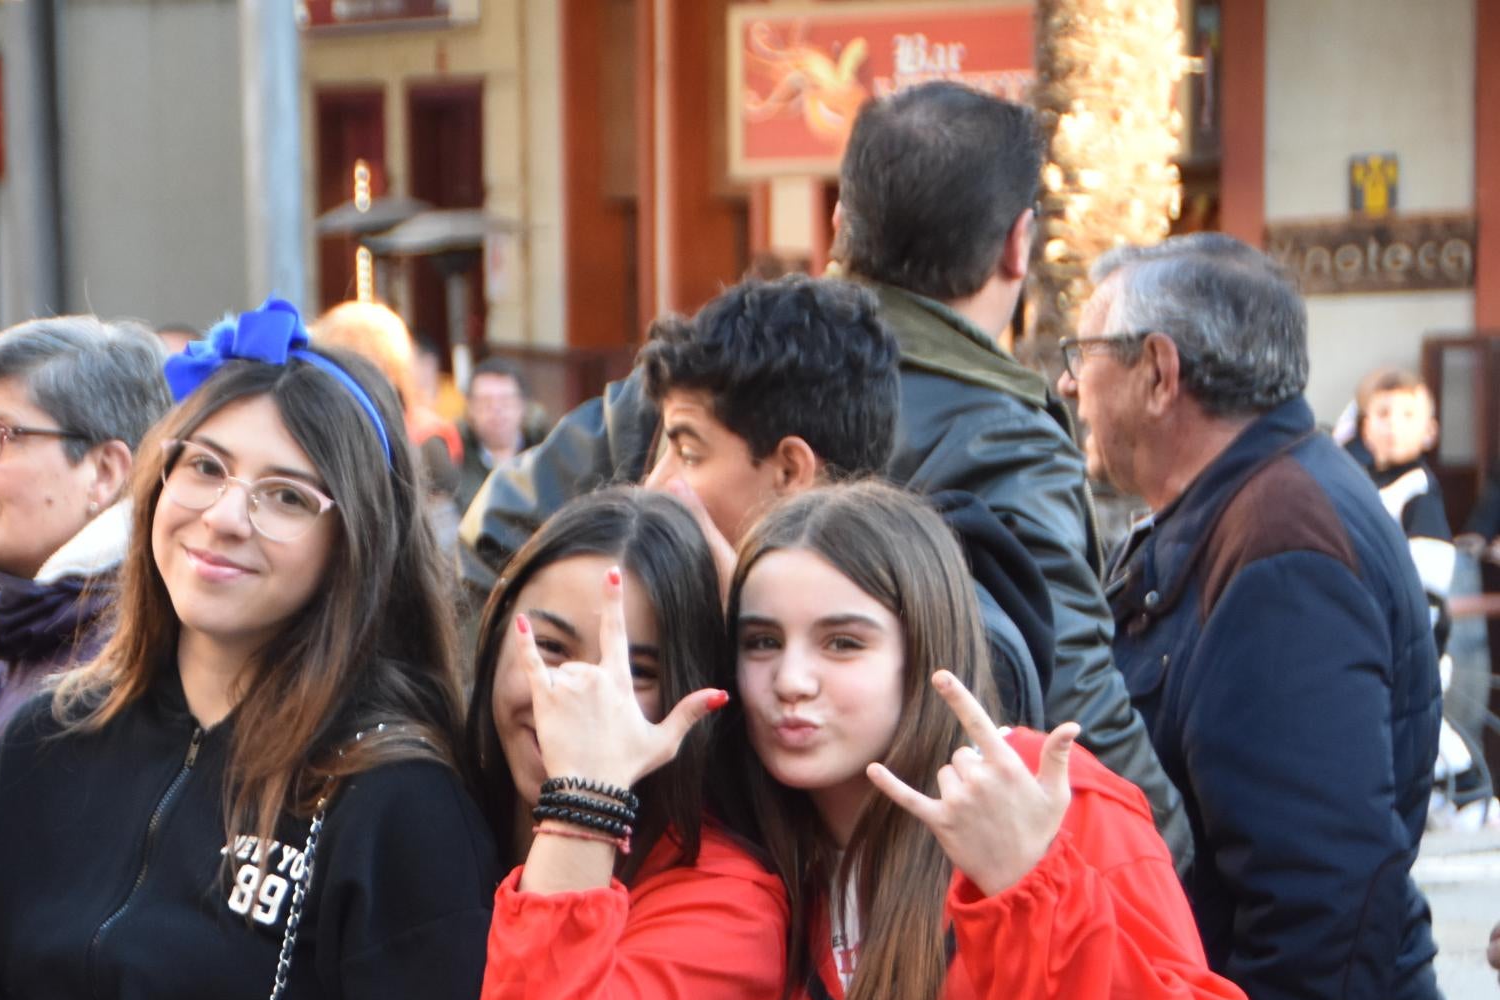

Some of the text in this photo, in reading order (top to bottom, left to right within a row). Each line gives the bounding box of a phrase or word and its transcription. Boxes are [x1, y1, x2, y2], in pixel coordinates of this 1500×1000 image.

[893, 33, 967, 73] Bar
[277, 845, 309, 880] YO
[228, 863, 289, 926] 89
